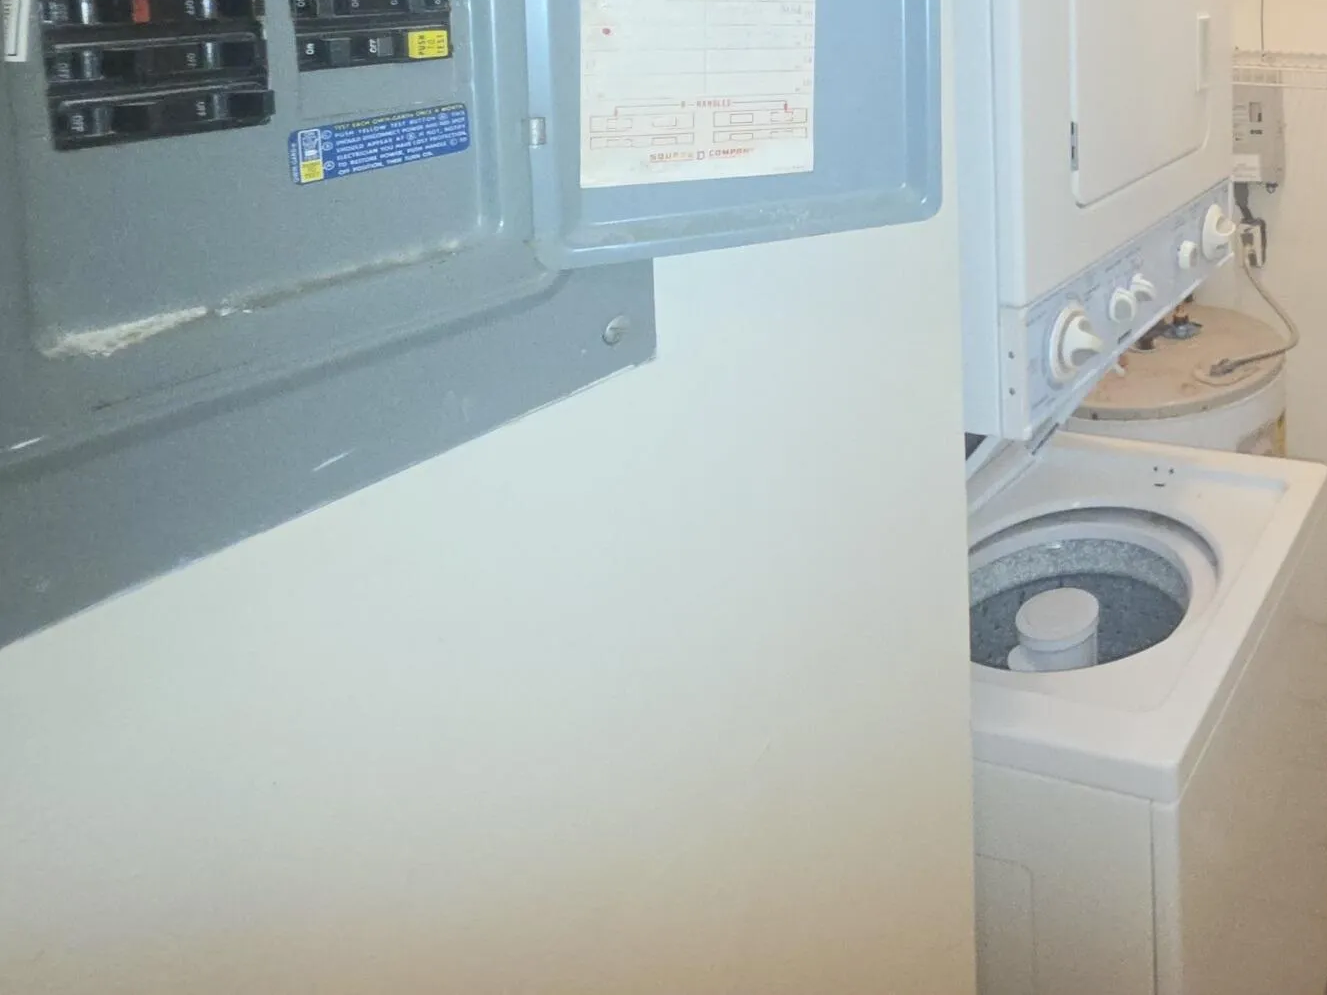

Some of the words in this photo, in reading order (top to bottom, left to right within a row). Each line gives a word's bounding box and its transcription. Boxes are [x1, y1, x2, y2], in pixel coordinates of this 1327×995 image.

[305, 43, 315, 55] ON
[369, 38, 378, 54] OFF
[418, 35, 426, 56] PUSH
[436, 35, 445, 54] TEST
